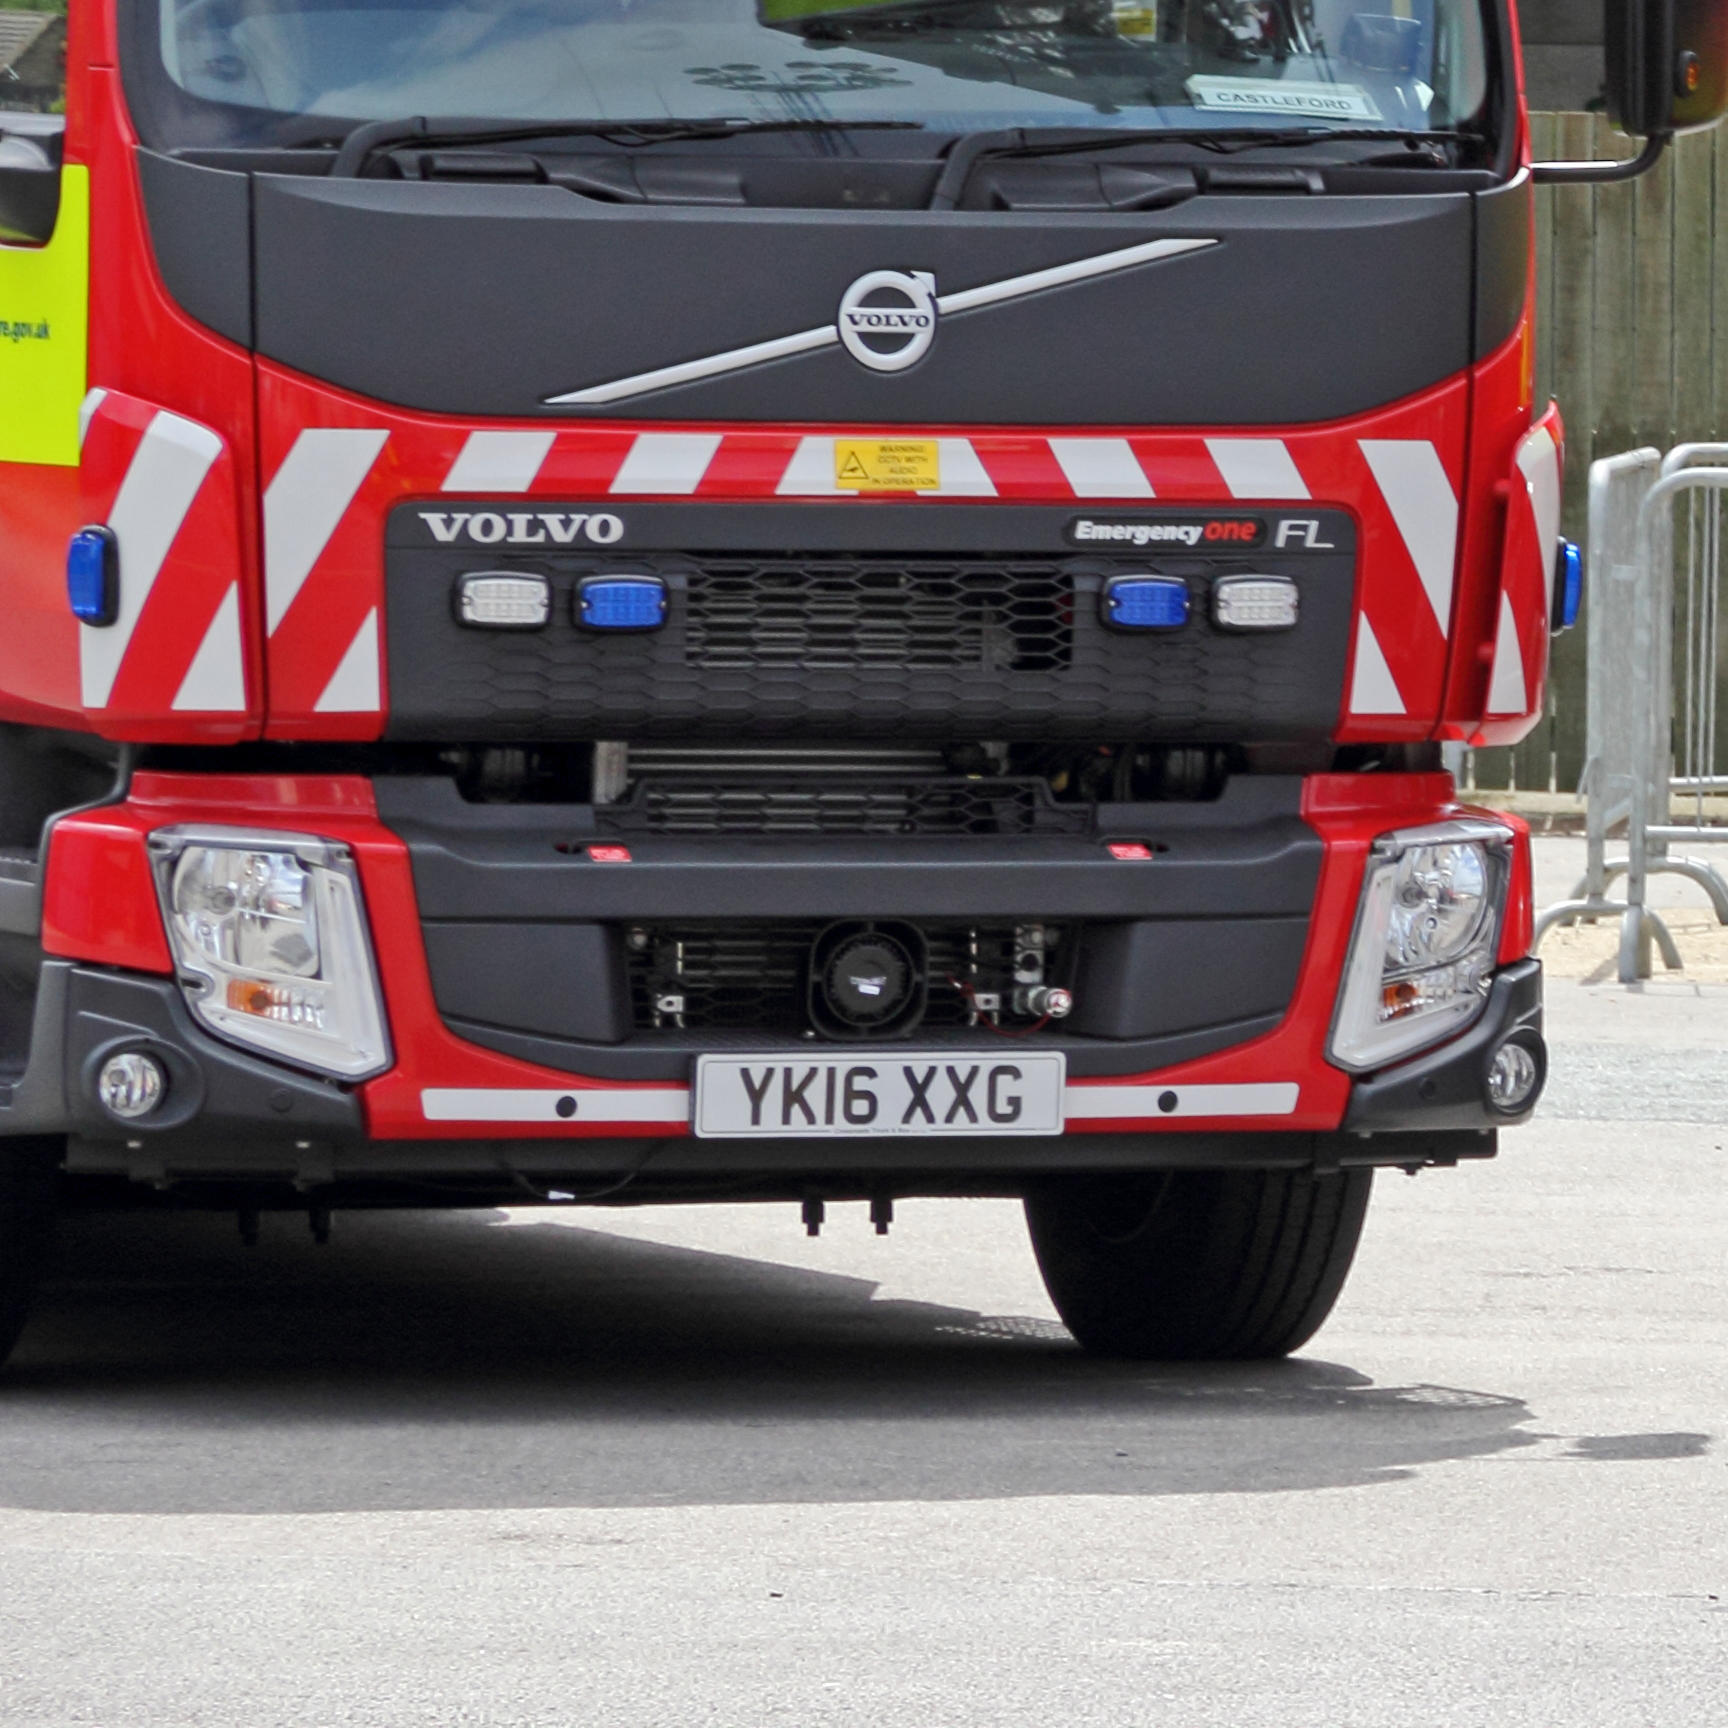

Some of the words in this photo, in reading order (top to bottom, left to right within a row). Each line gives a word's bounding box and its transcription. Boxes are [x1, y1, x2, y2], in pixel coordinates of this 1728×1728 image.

[1216, 92, 1352, 111] CASTLEFORD
[846, 313, 931, 329] VOLVO
[418, 511, 624, 544] VOLVO
[1275, 520, 1335, 548] FL
[739, 1065, 879, 1126] YK16
[900, 1064, 1023, 1125] XXG
